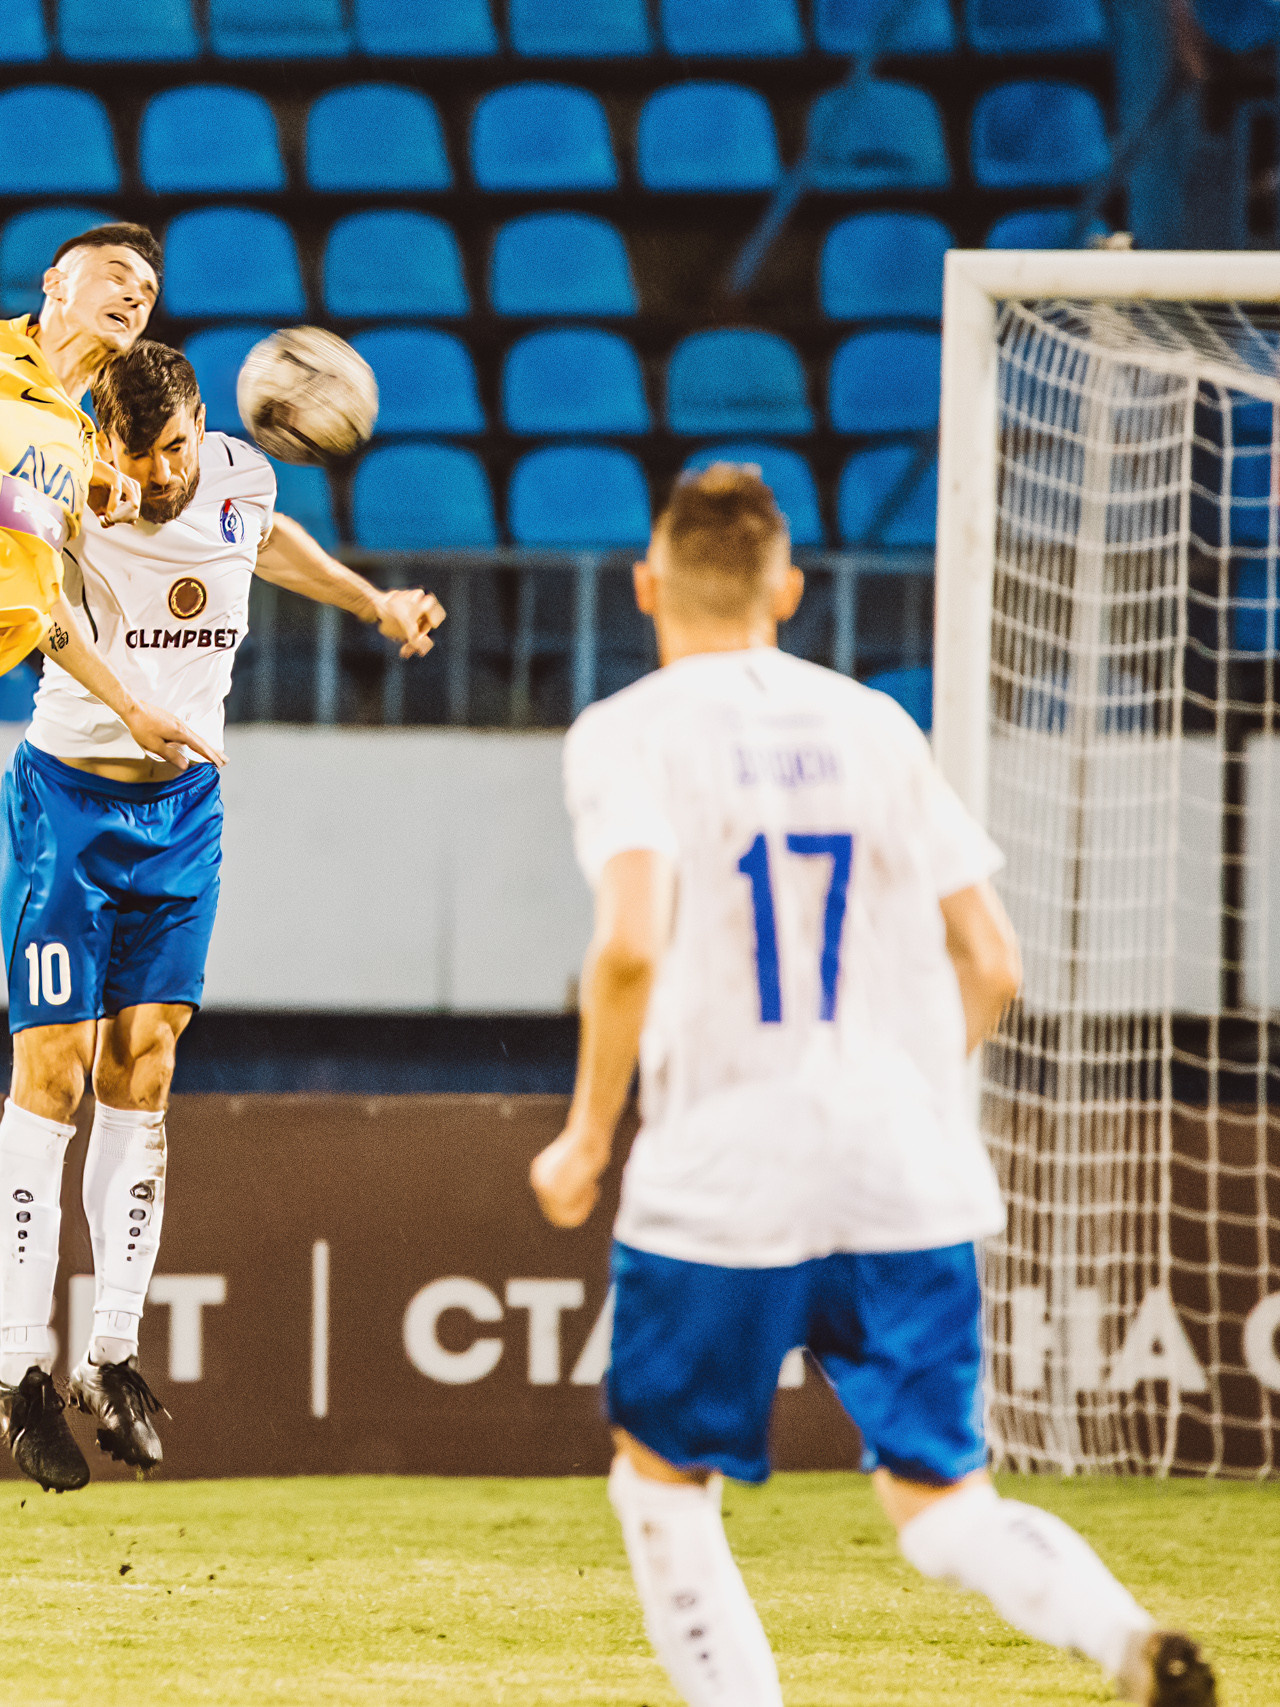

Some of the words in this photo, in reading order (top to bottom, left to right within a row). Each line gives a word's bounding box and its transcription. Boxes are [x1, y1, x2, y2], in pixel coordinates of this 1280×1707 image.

[8, 445, 75, 514] AVA
[126, 628, 238, 649] OLIMPBET
[736, 832, 853, 1024] 17
[24, 942, 72, 1006] 10
